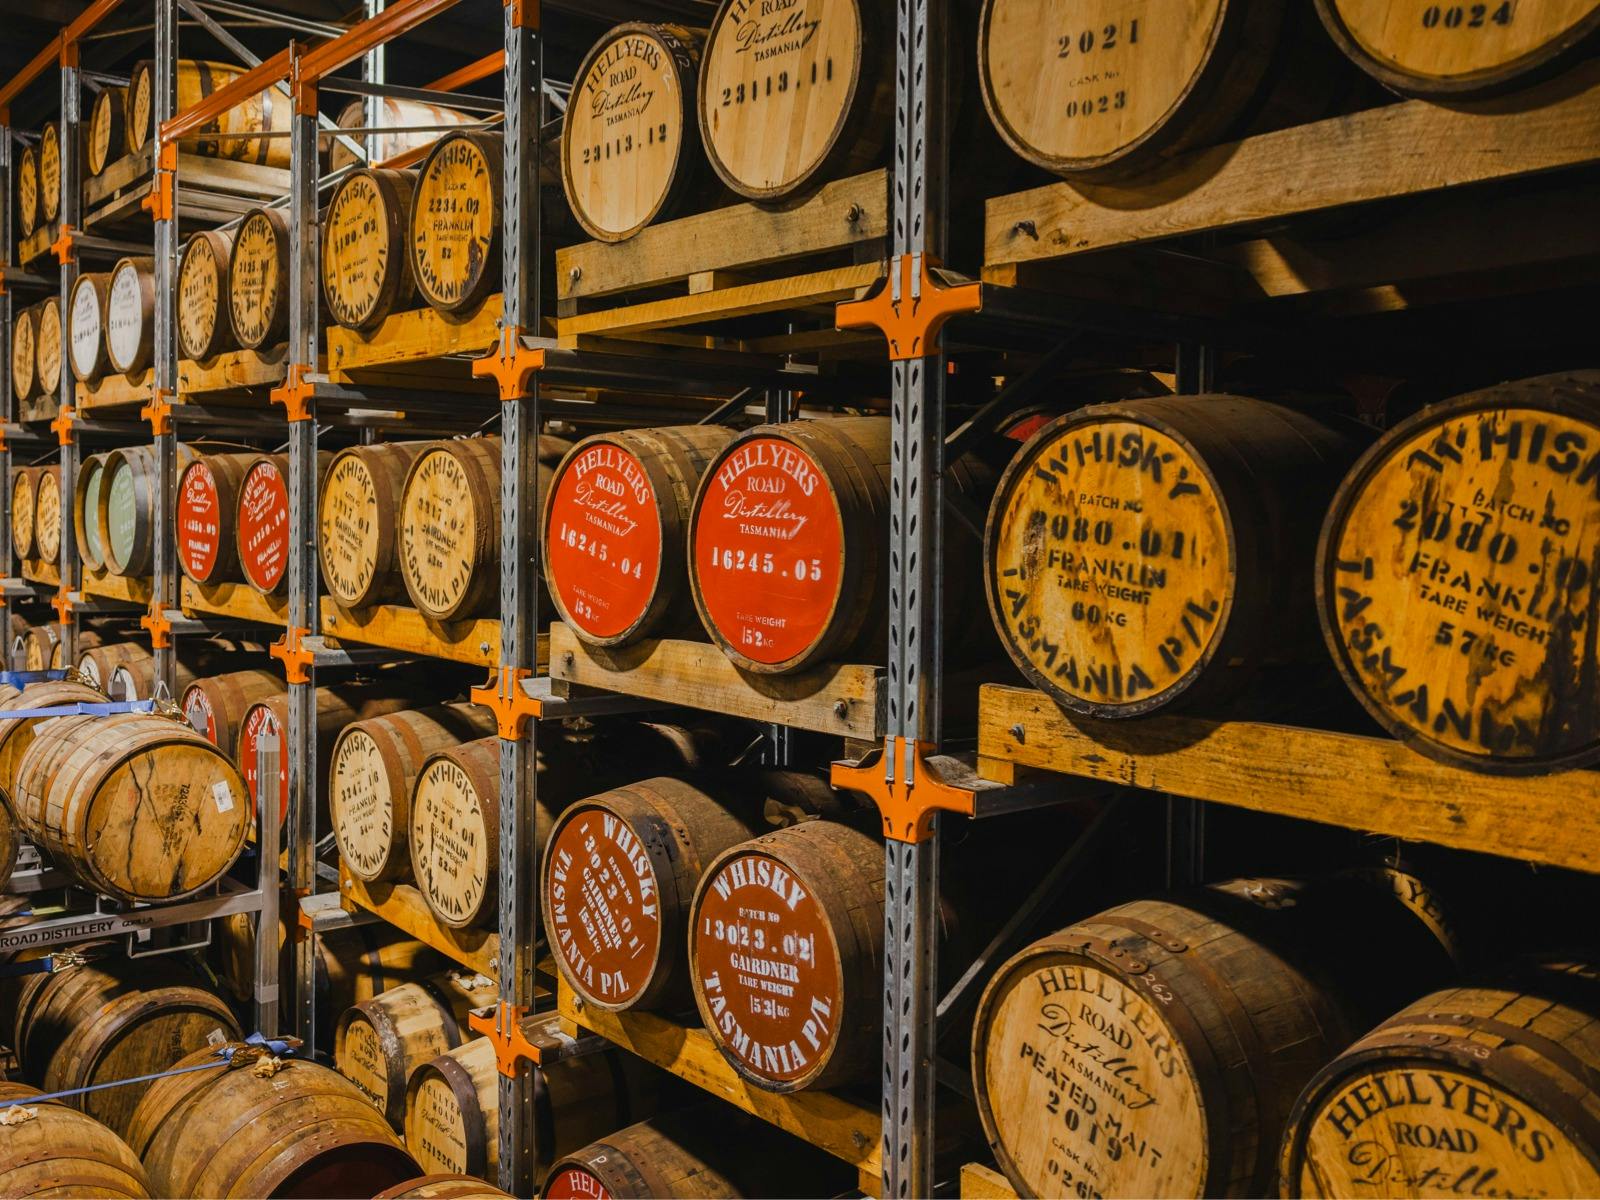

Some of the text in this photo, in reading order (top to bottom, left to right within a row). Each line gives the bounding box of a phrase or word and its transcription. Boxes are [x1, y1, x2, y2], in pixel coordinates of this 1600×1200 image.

[736, 9, 821, 53] Distillery
[1423, 0, 1511, 29] 0024
[754, 40, 800, 62] TASMANIA
[1057, 19, 1139, 58] 2021
[586, 39, 661, 94] HELLYERS
[609, 65, 637, 87] ROAD
[722, 57, 833, 107] 23113.11
[1069, 74, 1100, 88] CASK
[592, 81, 655, 119] Distillery
[606, 107, 641, 126] TASMANIA
[1066, 90, 1126, 118] 0023
[430, 145, 484, 181] WHISKY
[333, 181, 376, 226] WHISKY
[329, 269, 374, 320] TASMANIA
[336, 460, 376, 504] WHISKY
[420, 456, 468, 500] WHISKY
[574, 448, 650, 506] HELLYERS
[595, 473, 625, 497] ROAD
[717, 443, 819, 496] HELLYERS
[746, 476, 786, 494] ROAD
[1036, 431, 1201, 500] WHISKY
[573, 481, 639, 537] Distillery
[585, 511, 622, 537] TASMANIA
[722, 489, 808, 540] Distillery
[1079, 493, 1119, 509] BATCH
[1472, 487, 1536, 524] BATCH
[560, 523, 643, 579] 16245.04
[739, 523, 788, 540] TASMANIA
[323, 519, 357, 597] TASMANIA
[405, 523, 450, 607] TASMANIA
[711, 546, 822, 582] 16245.05
[1048, 549, 1167, 589] FRANKLIN
[1057, 575, 1152, 606] TARE WEIGHT
[754, 614, 787, 629] WEIGHT
[1003, 563, 1154, 699] TASMANIA
[1420, 584, 1554, 645] TARE WEIGHT
[338, 735, 376, 776] WHISKY
[428, 764, 480, 816] WHISKY
[340, 820, 386, 870] TASMANIA
[603, 813, 657, 921] WHISKY
[416, 823, 463, 915] TASMANIA
[608, 856, 634, 905] BATCH NO
[713, 858, 807, 912] WHISKY
[553, 847, 630, 998] TASMANIA P/L
[581, 883, 613, 949] TARE WEIGHT
[583, 867, 623, 950] GAIRDNER
[739, 907, 780, 923] BATCH NO
[0, 932, 38, 948] ROAD
[42, 920, 115, 942] DISTILLERY
[730, 952, 800, 984] GAIRDNER
[738, 974, 794, 998] TARE WEIGHT
[704, 971, 832, 1074] TASMANIA P/L
[1036, 966, 1182, 1079] HELLYERS
[1079, 1002, 1133, 1051] ROAD
[1020, 1042, 1098, 1116] PEATED
[1038, 1003, 1161, 1110] Distillery
[1062, 1051, 1128, 1108] TASMANIA
[1046, 1090, 1123, 1162] 2019
[1326, 1072, 1555, 1163] HELLYERS
[1393, 1121, 1479, 1154] ROAD
[1052, 1137, 1080, 1164] CASK
